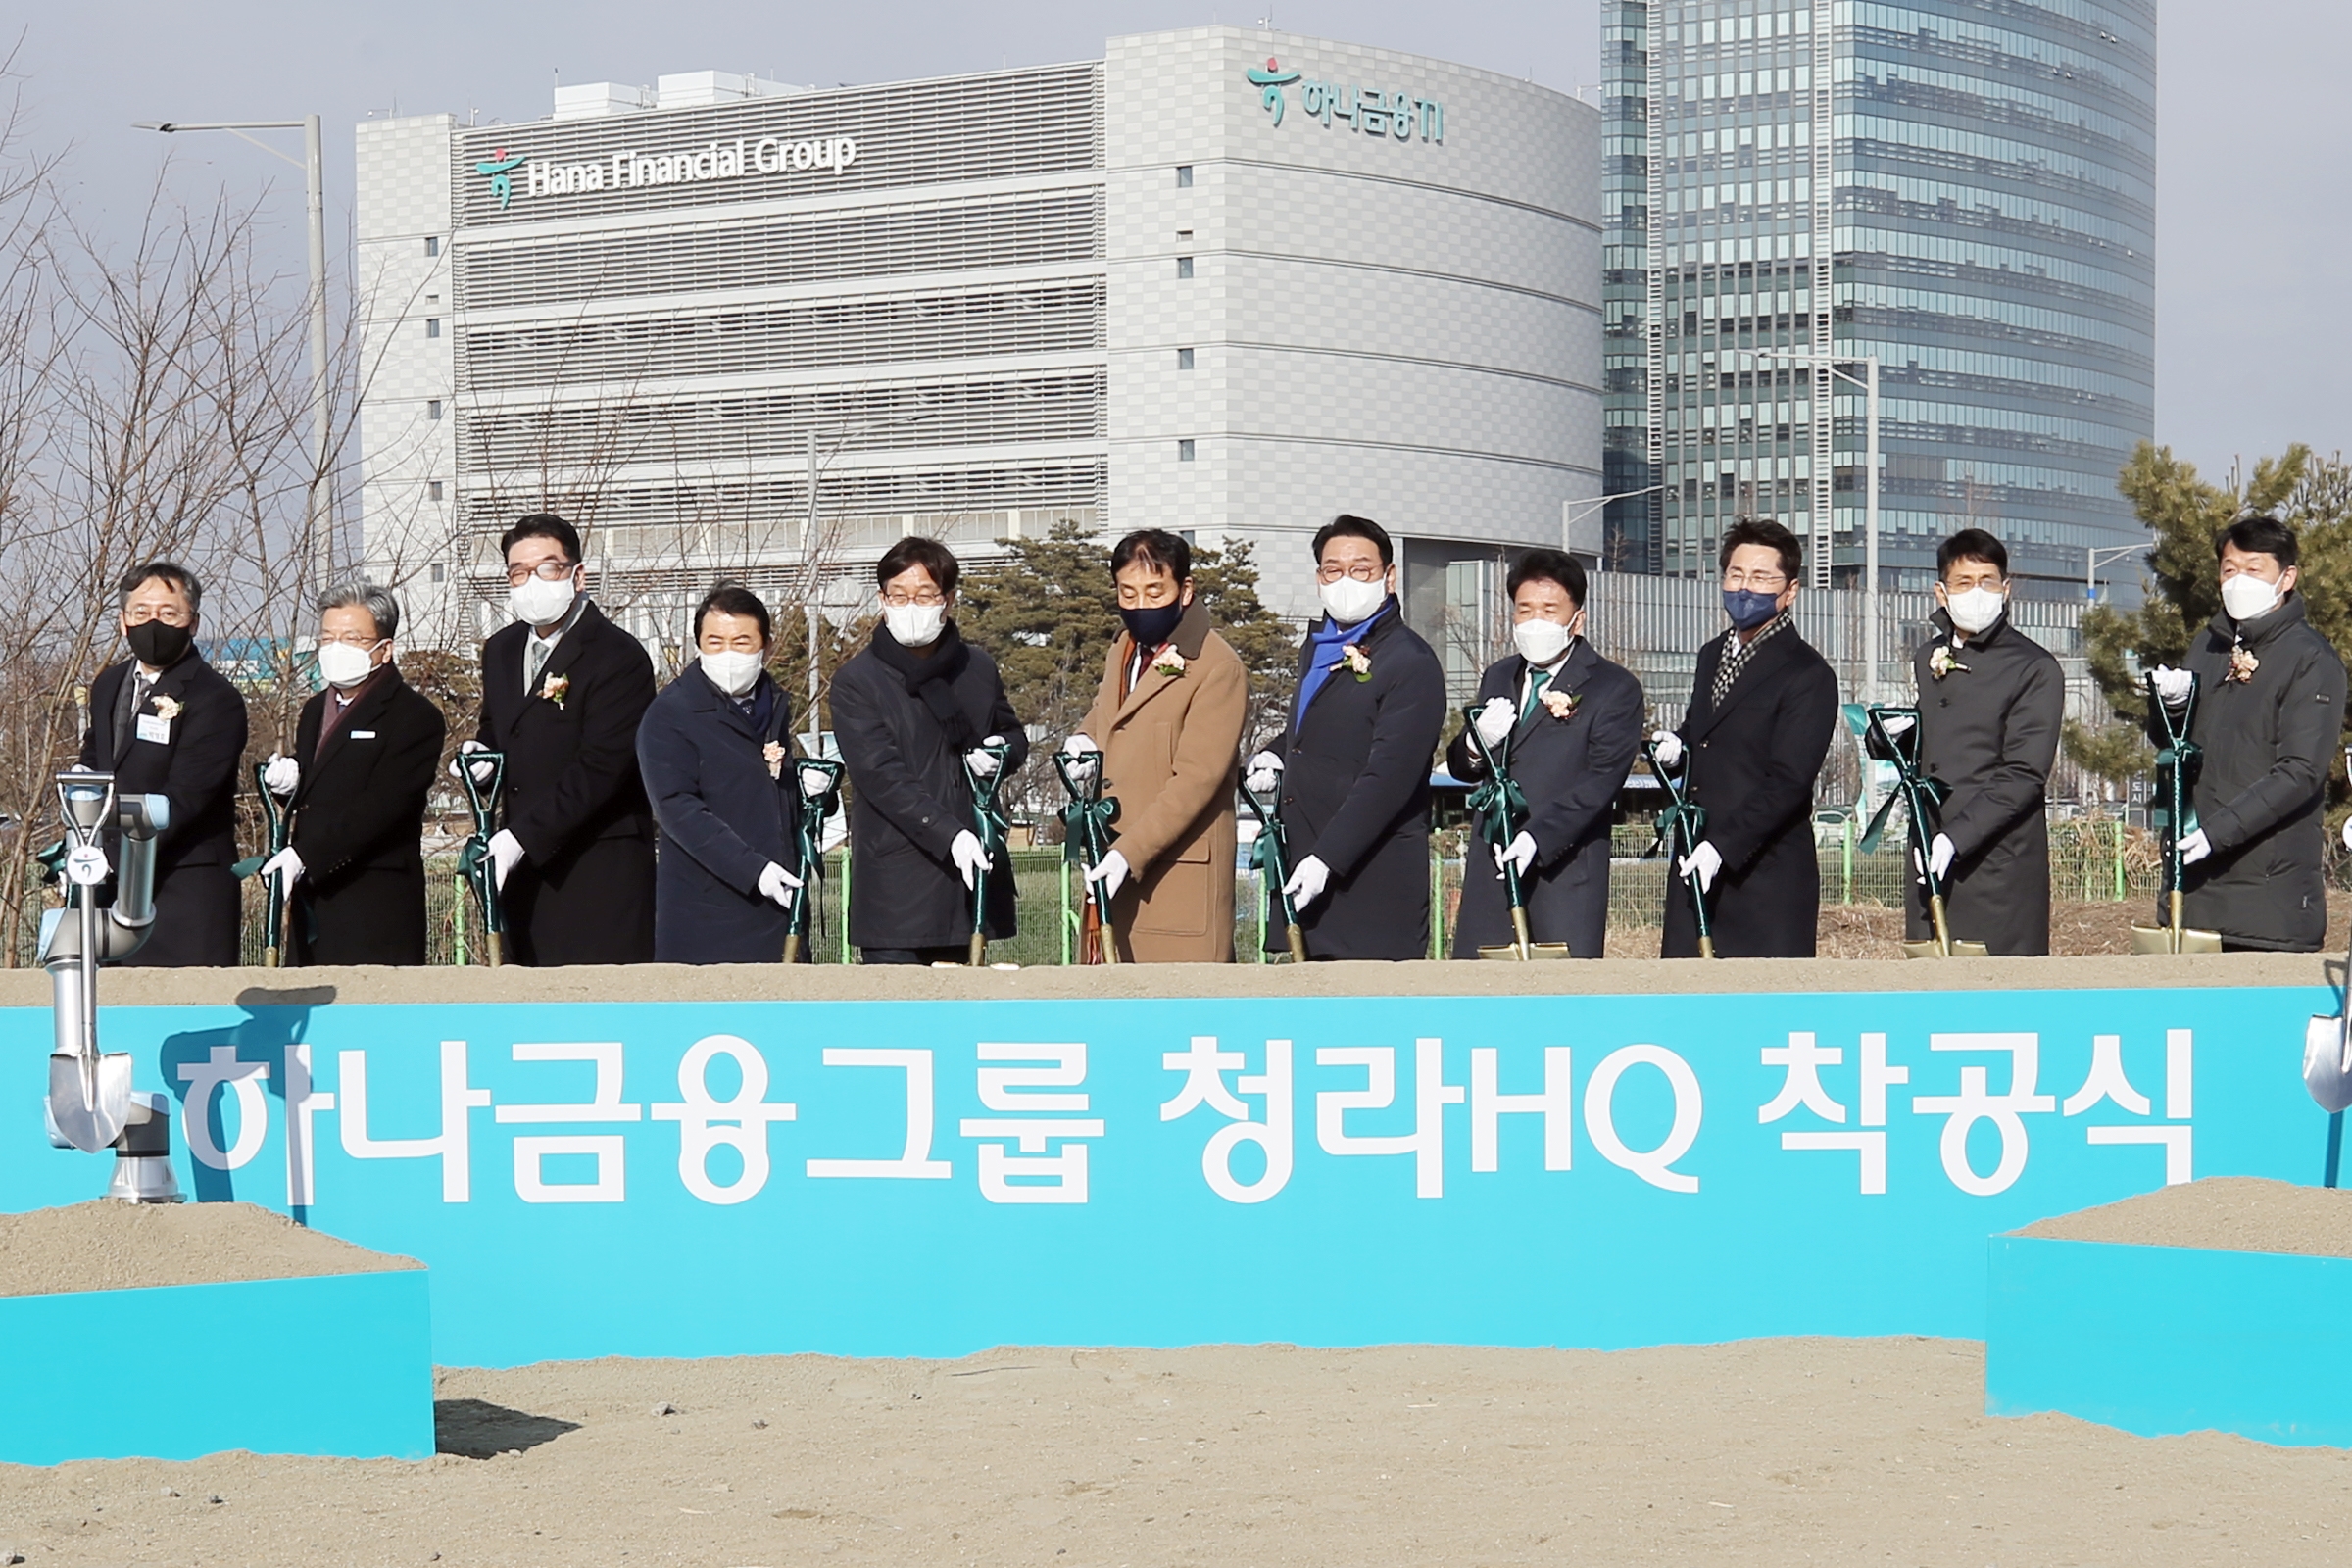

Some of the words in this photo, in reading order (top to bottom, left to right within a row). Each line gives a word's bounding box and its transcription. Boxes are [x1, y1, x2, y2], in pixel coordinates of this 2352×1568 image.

[1302, 79, 1444, 141] 하나금융TI
[528, 161, 604, 197] Hana
[612, 139, 745, 188] Financial
[754, 137, 857, 175] Group
[176, 1034, 1105, 1206] 하나금융그룹
[1159, 1035, 1704, 1204] 청라HQ
[1758, 1028, 2193, 1196] 착공식
